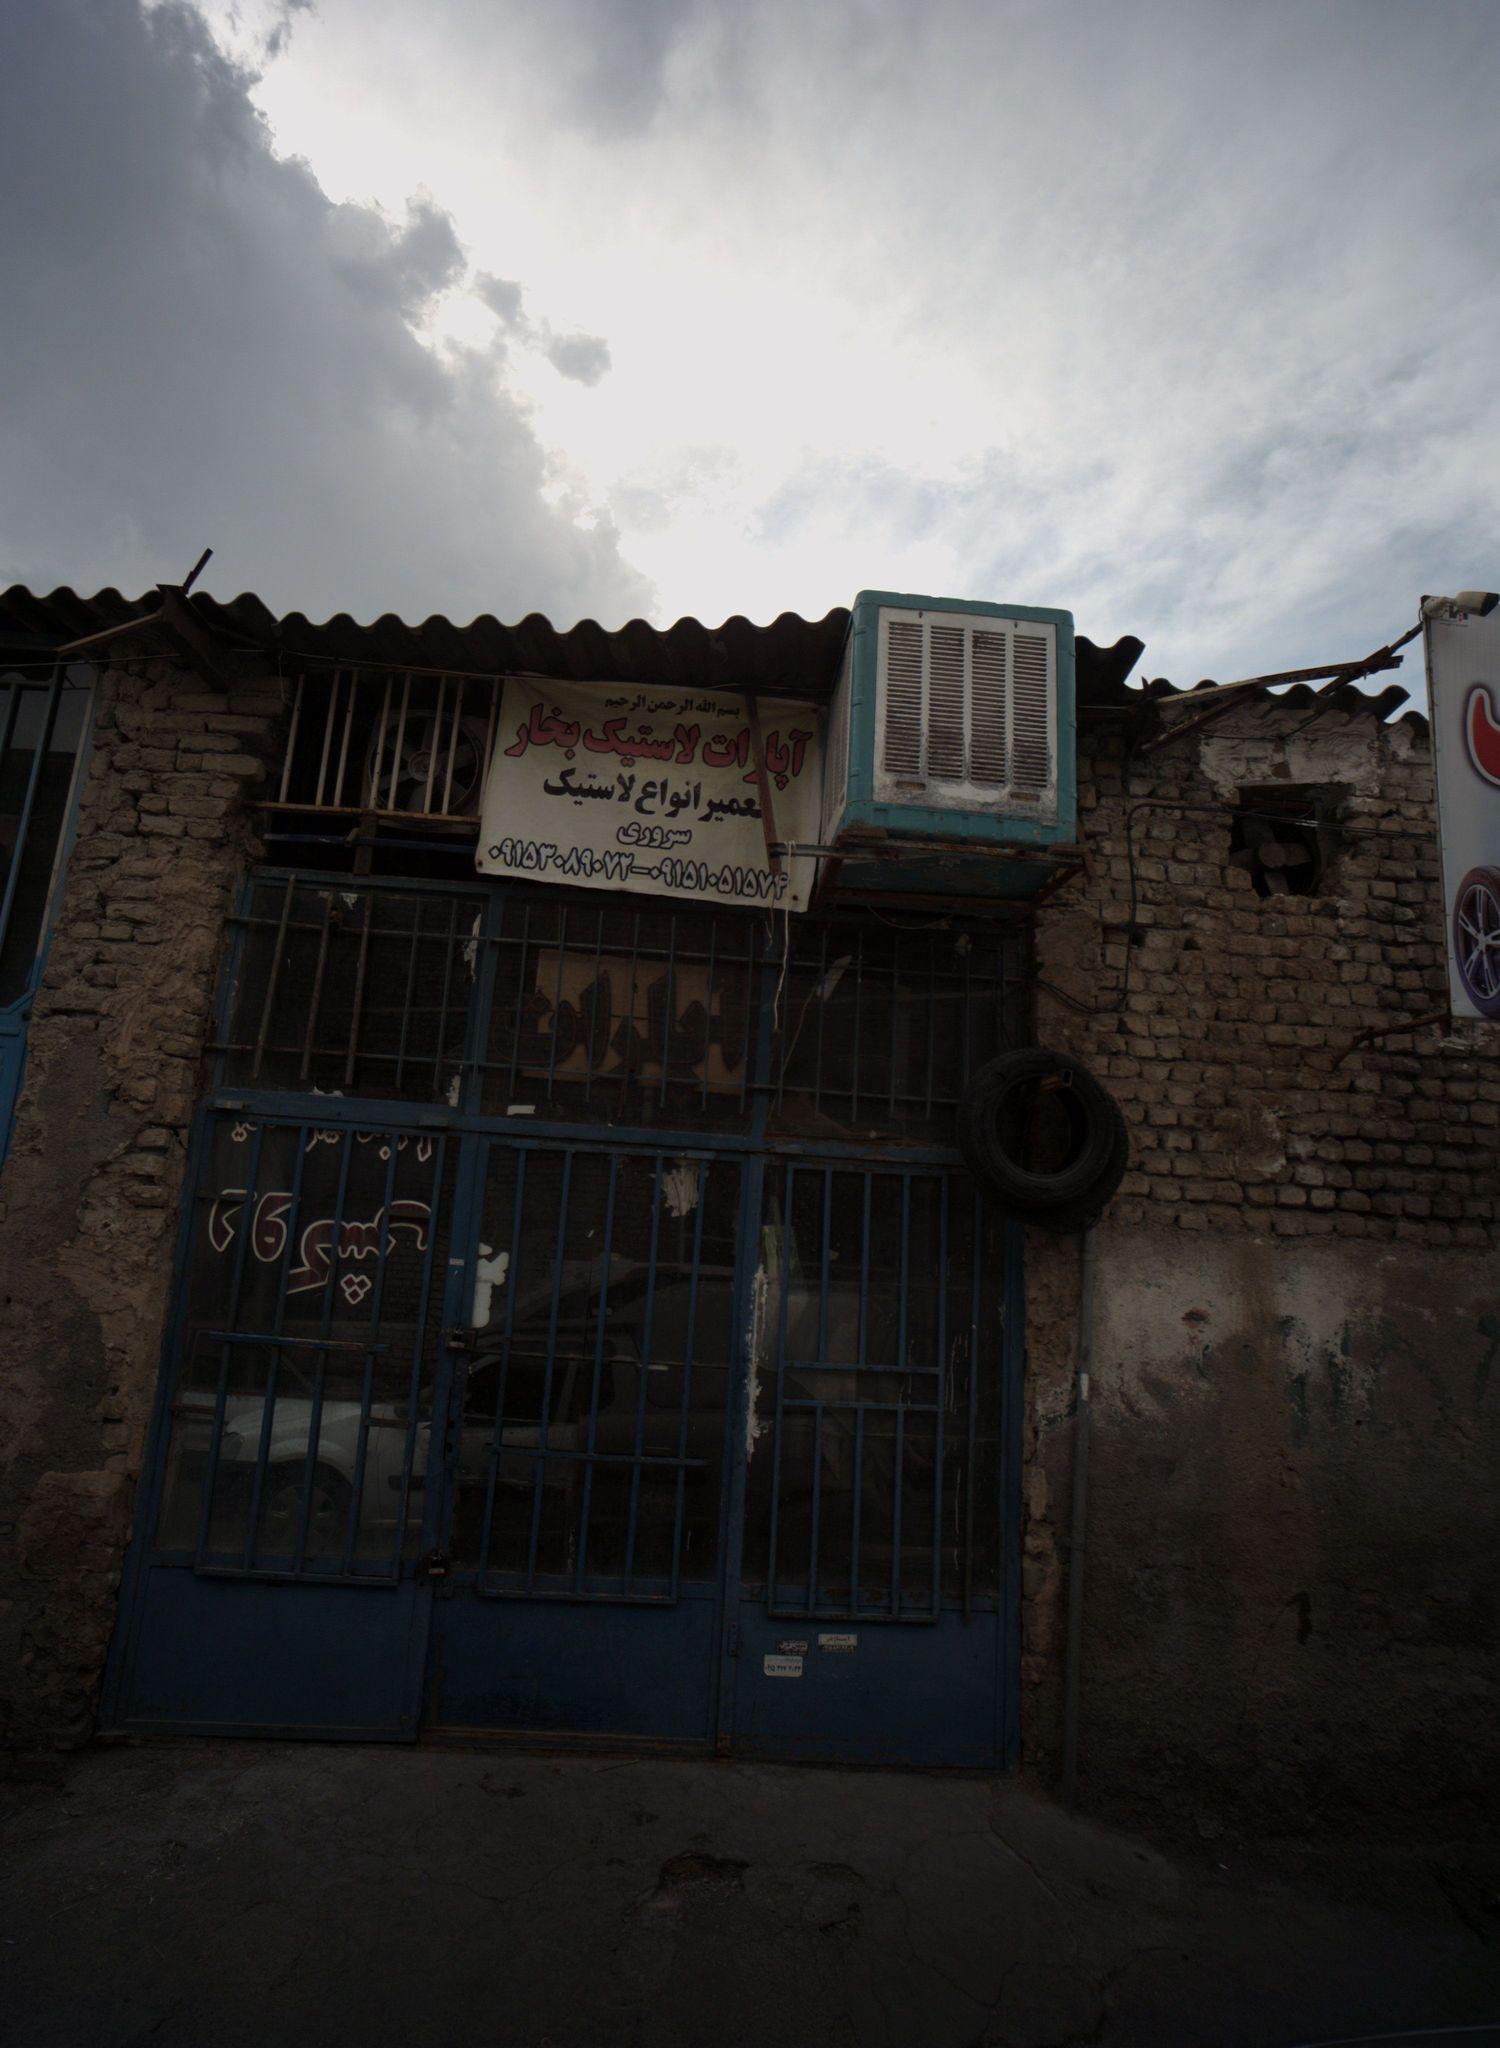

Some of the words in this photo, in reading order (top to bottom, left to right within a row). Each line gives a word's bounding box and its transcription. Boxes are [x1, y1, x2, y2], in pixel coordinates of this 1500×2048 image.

[648, 697, 693, 716] الرحمن
[696, 701, 716, 714] الله
[717, 703, 740, 719] بسم
[504, 703, 581, 760] بخار
[582, 718, 701, 768] لاستیک
[543, 767, 636, 806] لاستیک
[634, 778, 702, 818] انواع
[698, 797, 763, 822] عمیر
[616, 821, 692, 849] سروری
